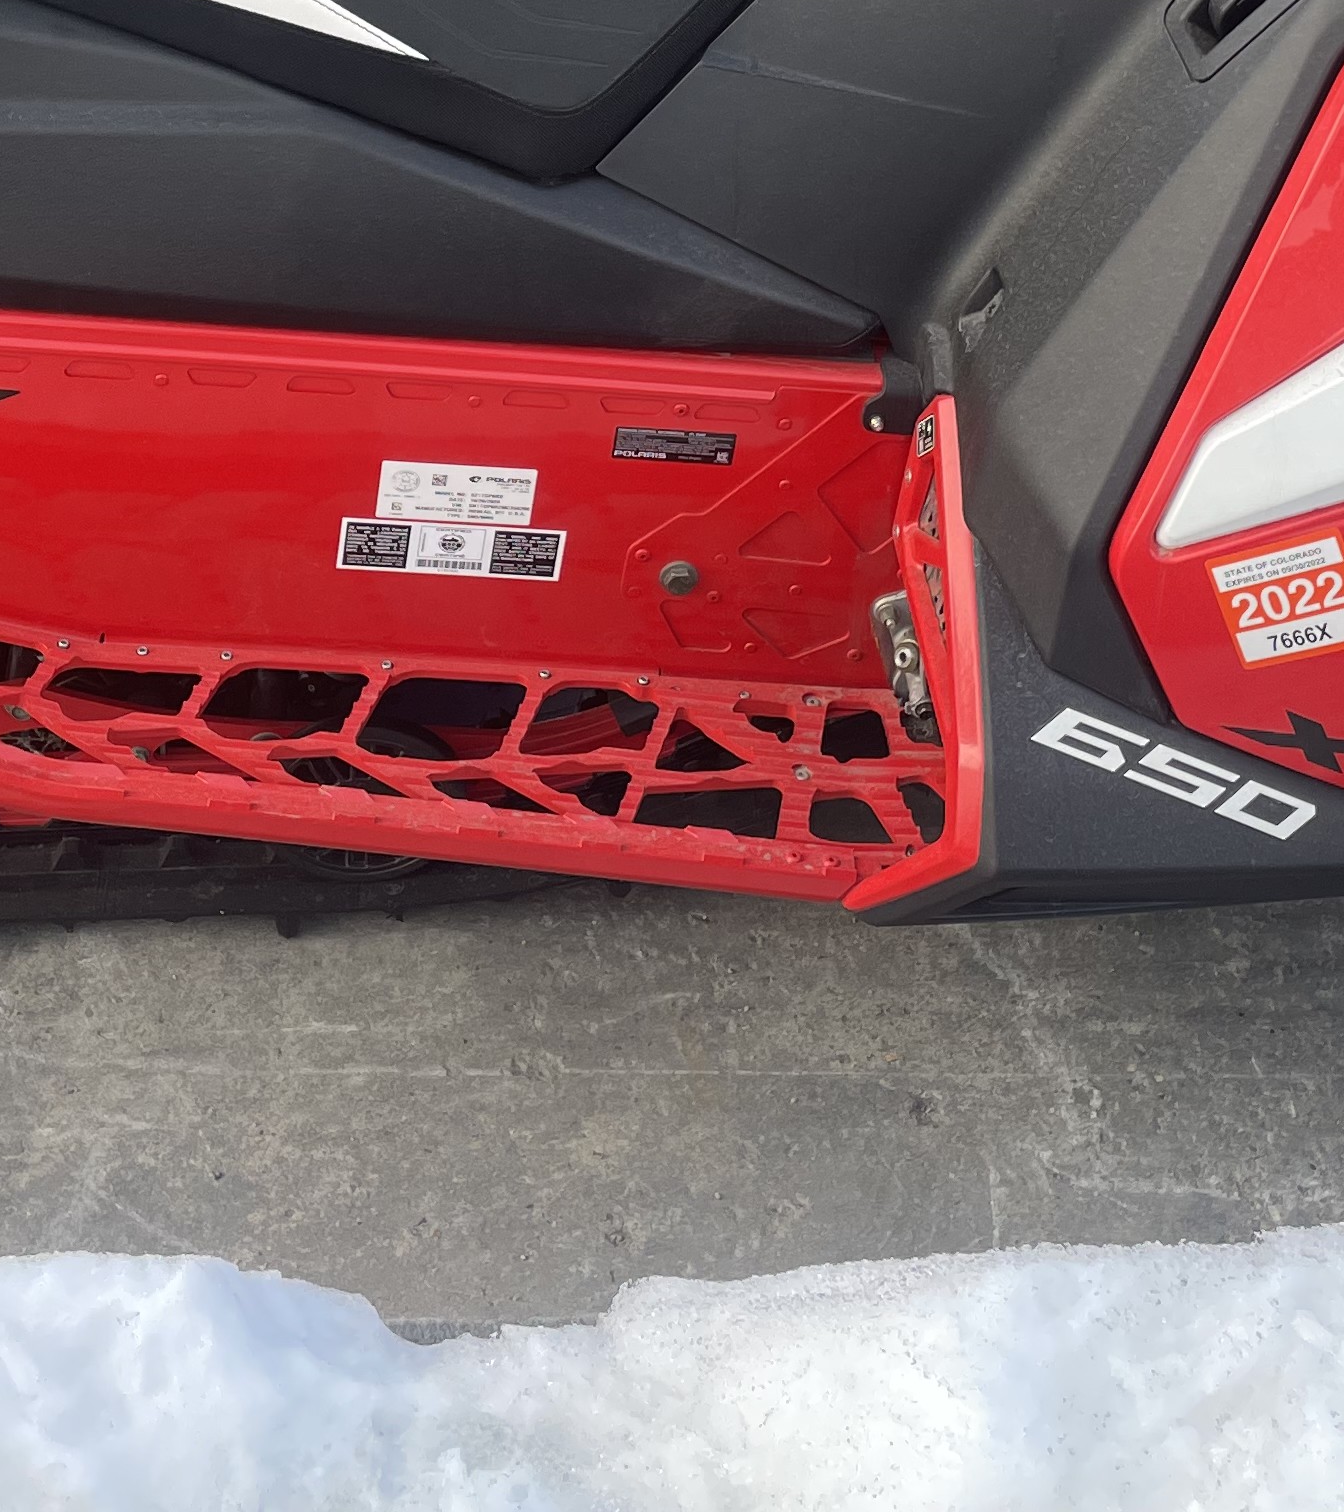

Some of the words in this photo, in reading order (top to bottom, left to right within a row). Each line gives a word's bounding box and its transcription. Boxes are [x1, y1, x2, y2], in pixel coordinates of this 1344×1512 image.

[614, 450, 667, 459] POLARIS
[1224, 563, 1253, 578] STATE
[1256, 560, 1268, 570] OF
[1270, 547, 1322, 566] COLORADO
[1225, 573, 1264, 588] EXPIRES
[1266, 569, 1279, 578] ON
[1267, 623, 1333, 651] 7666X
[1030, 707, 1316, 840] 650
